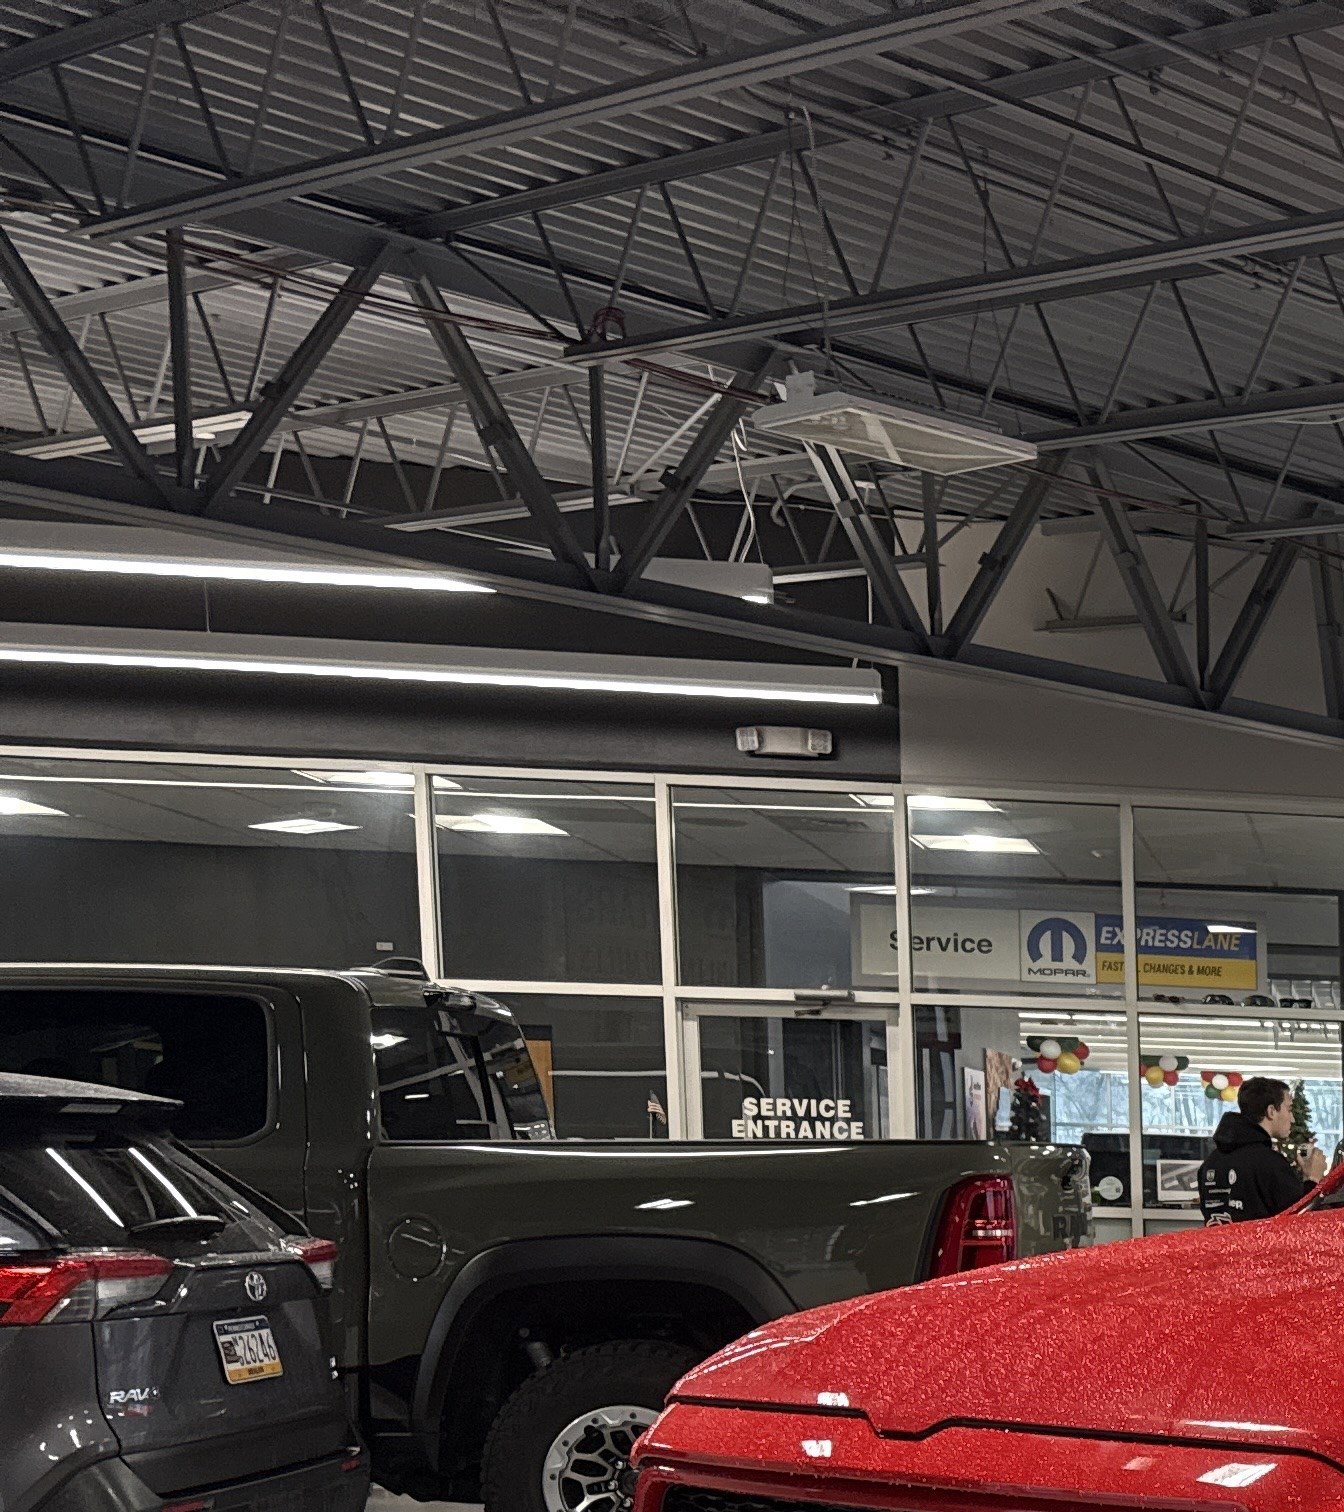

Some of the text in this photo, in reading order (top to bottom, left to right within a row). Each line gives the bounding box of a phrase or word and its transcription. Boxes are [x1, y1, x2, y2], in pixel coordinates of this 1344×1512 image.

[1027, 967, 1087, 978] MOPAR
[1102, 961, 1125, 972] FAST
[1143, 963, 1185, 976] CHANGES
[1196, 966, 1222, 976] MORE
[743, 1097, 852, 1118] SERVICE
[731, 1119, 864, 1140] ENTRANCE
